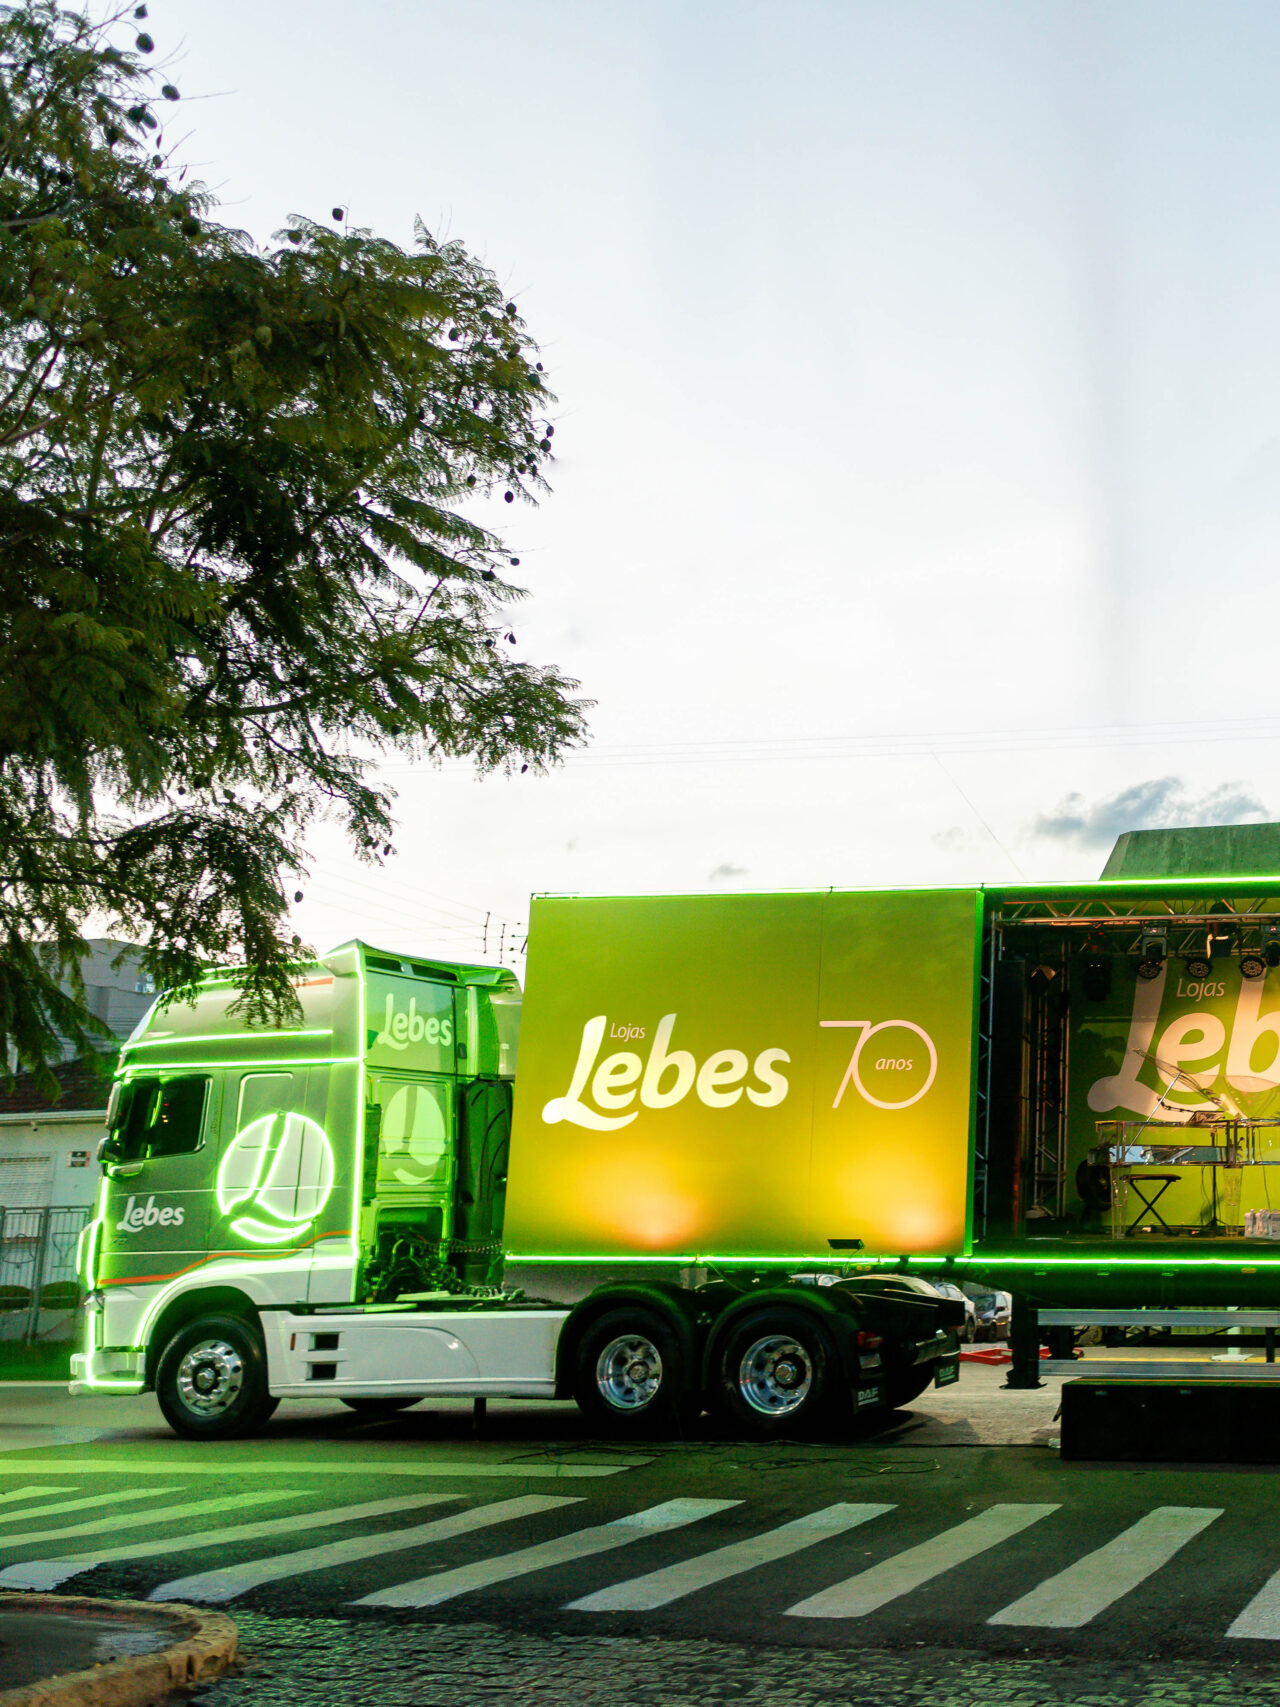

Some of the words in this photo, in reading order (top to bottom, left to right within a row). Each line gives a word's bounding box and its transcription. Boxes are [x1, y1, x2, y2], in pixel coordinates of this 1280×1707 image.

[1176, 977, 1226, 1002] Lojas
[377, 993, 453, 1051] Lebes
[610, 1022, 646, 1042] Lojas
[541, 1013, 792, 1132] Lebes
[819, 1019, 938, 1110] 70
[875, 1057, 914, 1071] anos
[116, 1195, 185, 1233] Lebes
[858, 1387, 879, 1401] DAF
